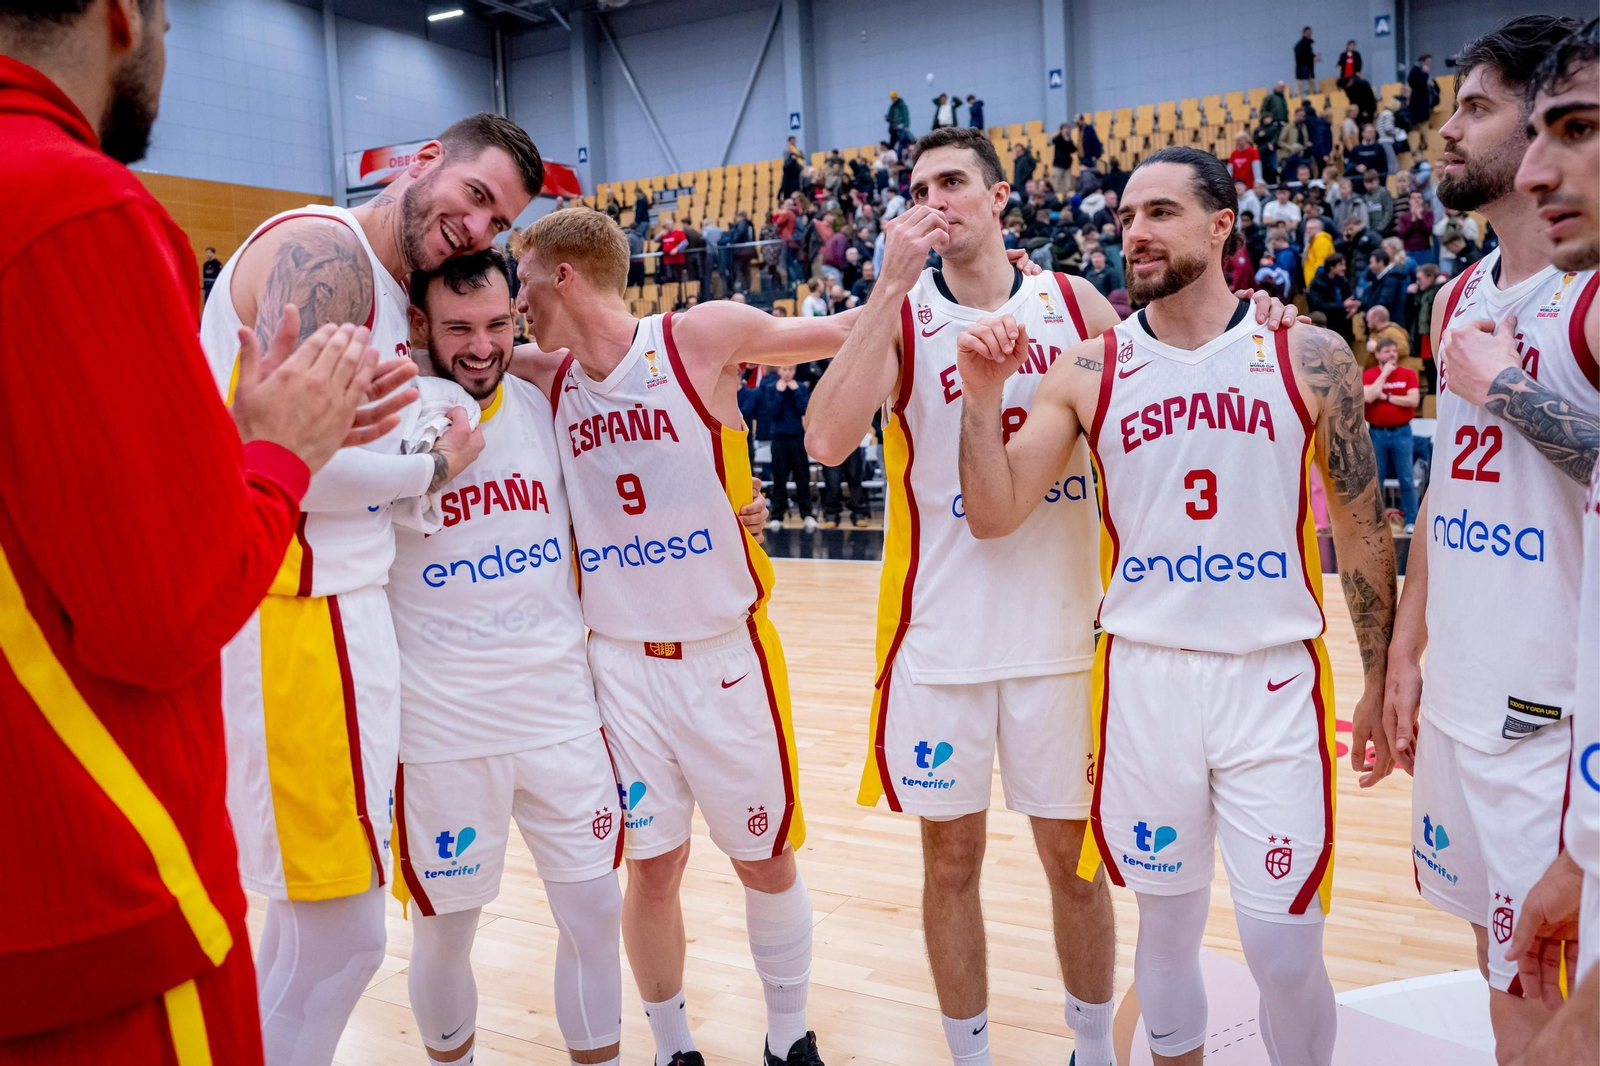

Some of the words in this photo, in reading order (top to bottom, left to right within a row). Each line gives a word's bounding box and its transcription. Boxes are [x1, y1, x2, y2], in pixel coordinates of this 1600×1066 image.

[1376, 18, 1389, 34] A
[1051, 72, 1061, 86] A
[791, 115, 801, 127] A
[568, 403, 680, 458] ESPAÑA
[1120, 387, 1275, 454] ESPAÑA
[1451, 425, 1502, 483] 22
[424, 473, 550, 538] SPAÑA
[615, 473, 647, 516] 9
[1184, 469, 1218, 520] 3
[580, 528, 713, 572] endesa
[1433, 508, 1545, 562] ndesa
[422, 537, 561, 588] endesa
[1122, 545, 1287, 582] endesa
[1530, 706, 1545, 714] CADA
[902, 776, 955, 791] tenerife!
[625, 815, 655, 829] erife!
[424, 864, 481, 879] tenerife!
[1122, 854, 1182, 874] tenerife!
[1412, 844, 1459, 886] tenerife!
